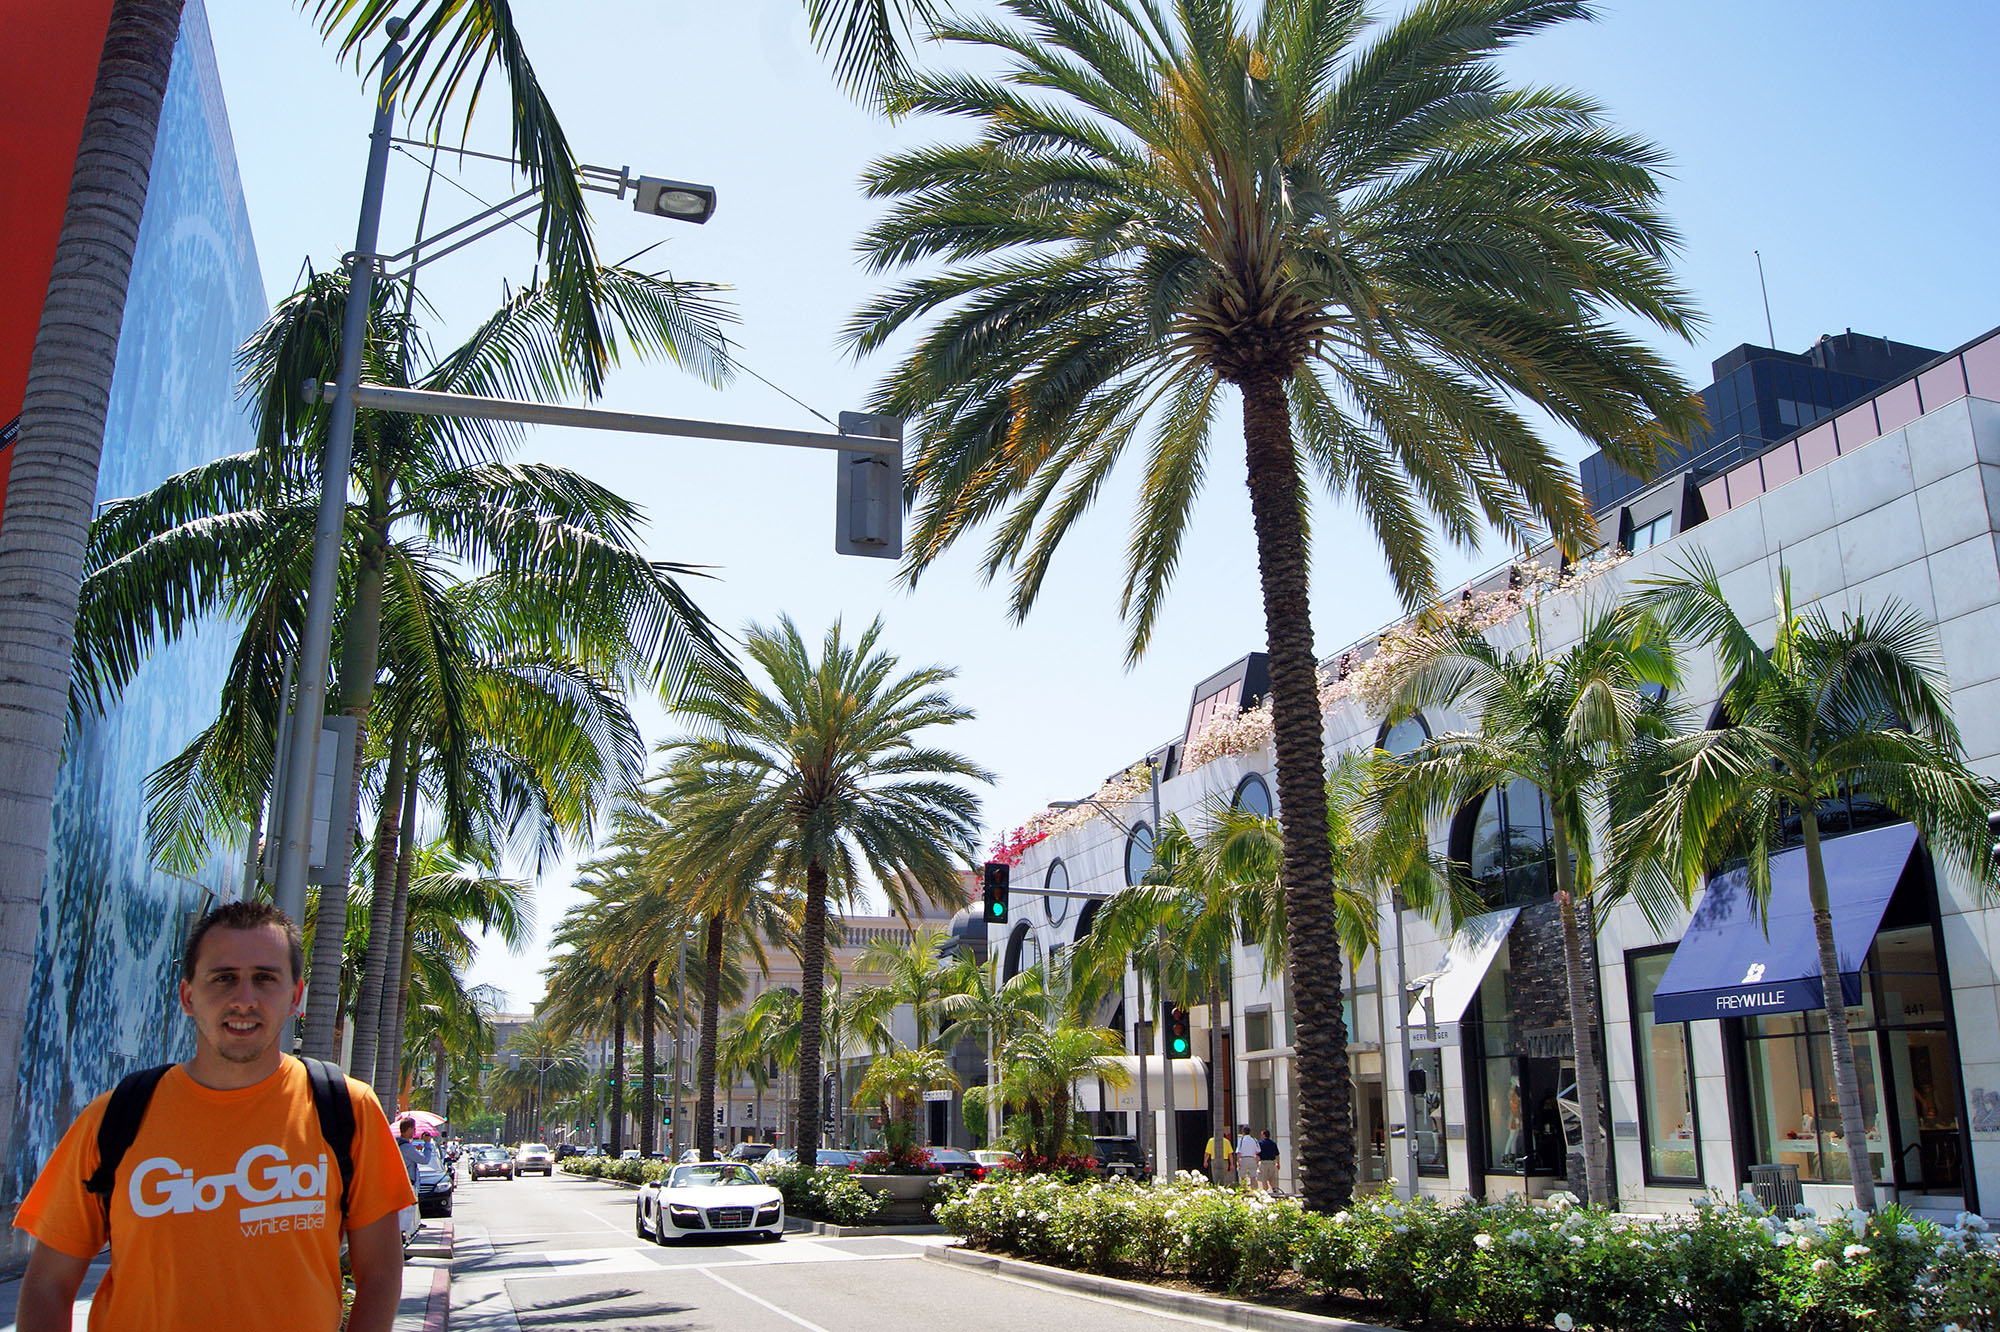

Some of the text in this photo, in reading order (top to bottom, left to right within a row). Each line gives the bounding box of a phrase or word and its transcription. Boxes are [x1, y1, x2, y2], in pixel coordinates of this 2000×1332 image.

[1716, 990, 1785, 1010] FREYWILLE
[1904, 1003, 1924, 1016] 441
[240, 1214, 325, 1238] white label
